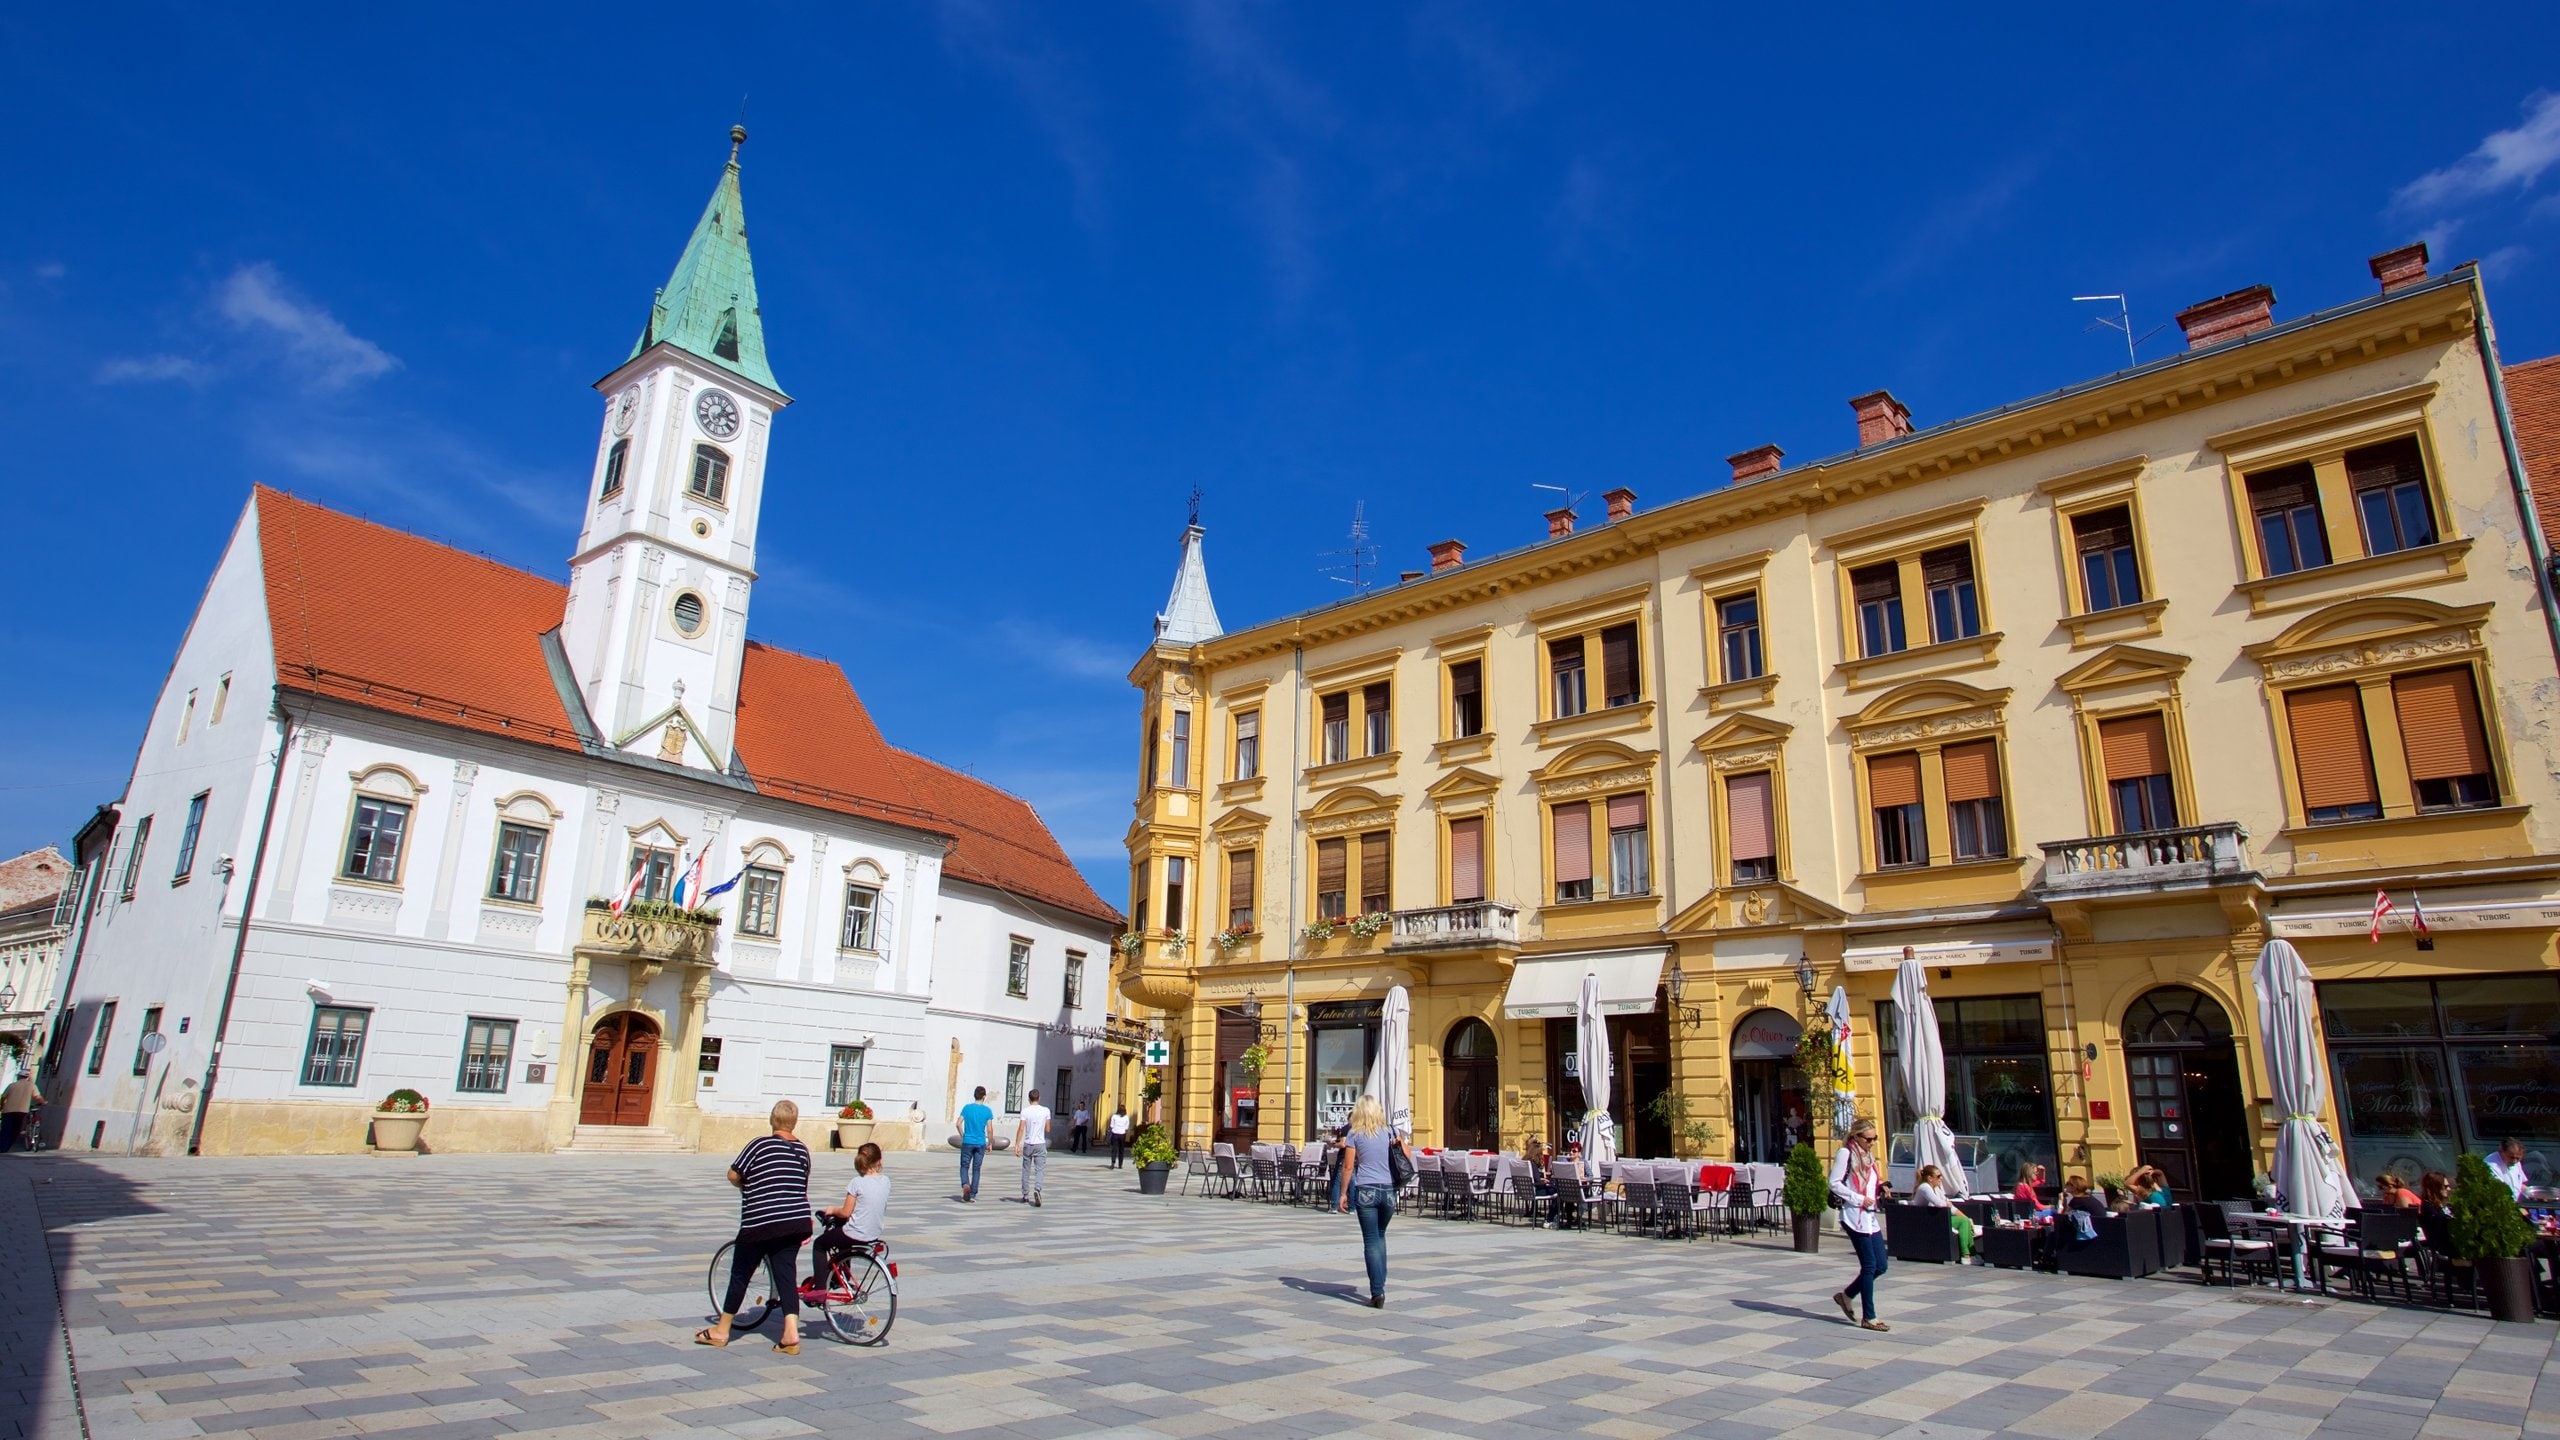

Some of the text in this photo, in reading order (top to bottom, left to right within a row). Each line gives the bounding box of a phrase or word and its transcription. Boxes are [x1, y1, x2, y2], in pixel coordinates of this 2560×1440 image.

[2338, 920, 2367, 928] TUBORG
[2477, 913, 2510, 921] TUBORG
[2020, 948, 2042, 956] TUBORG
